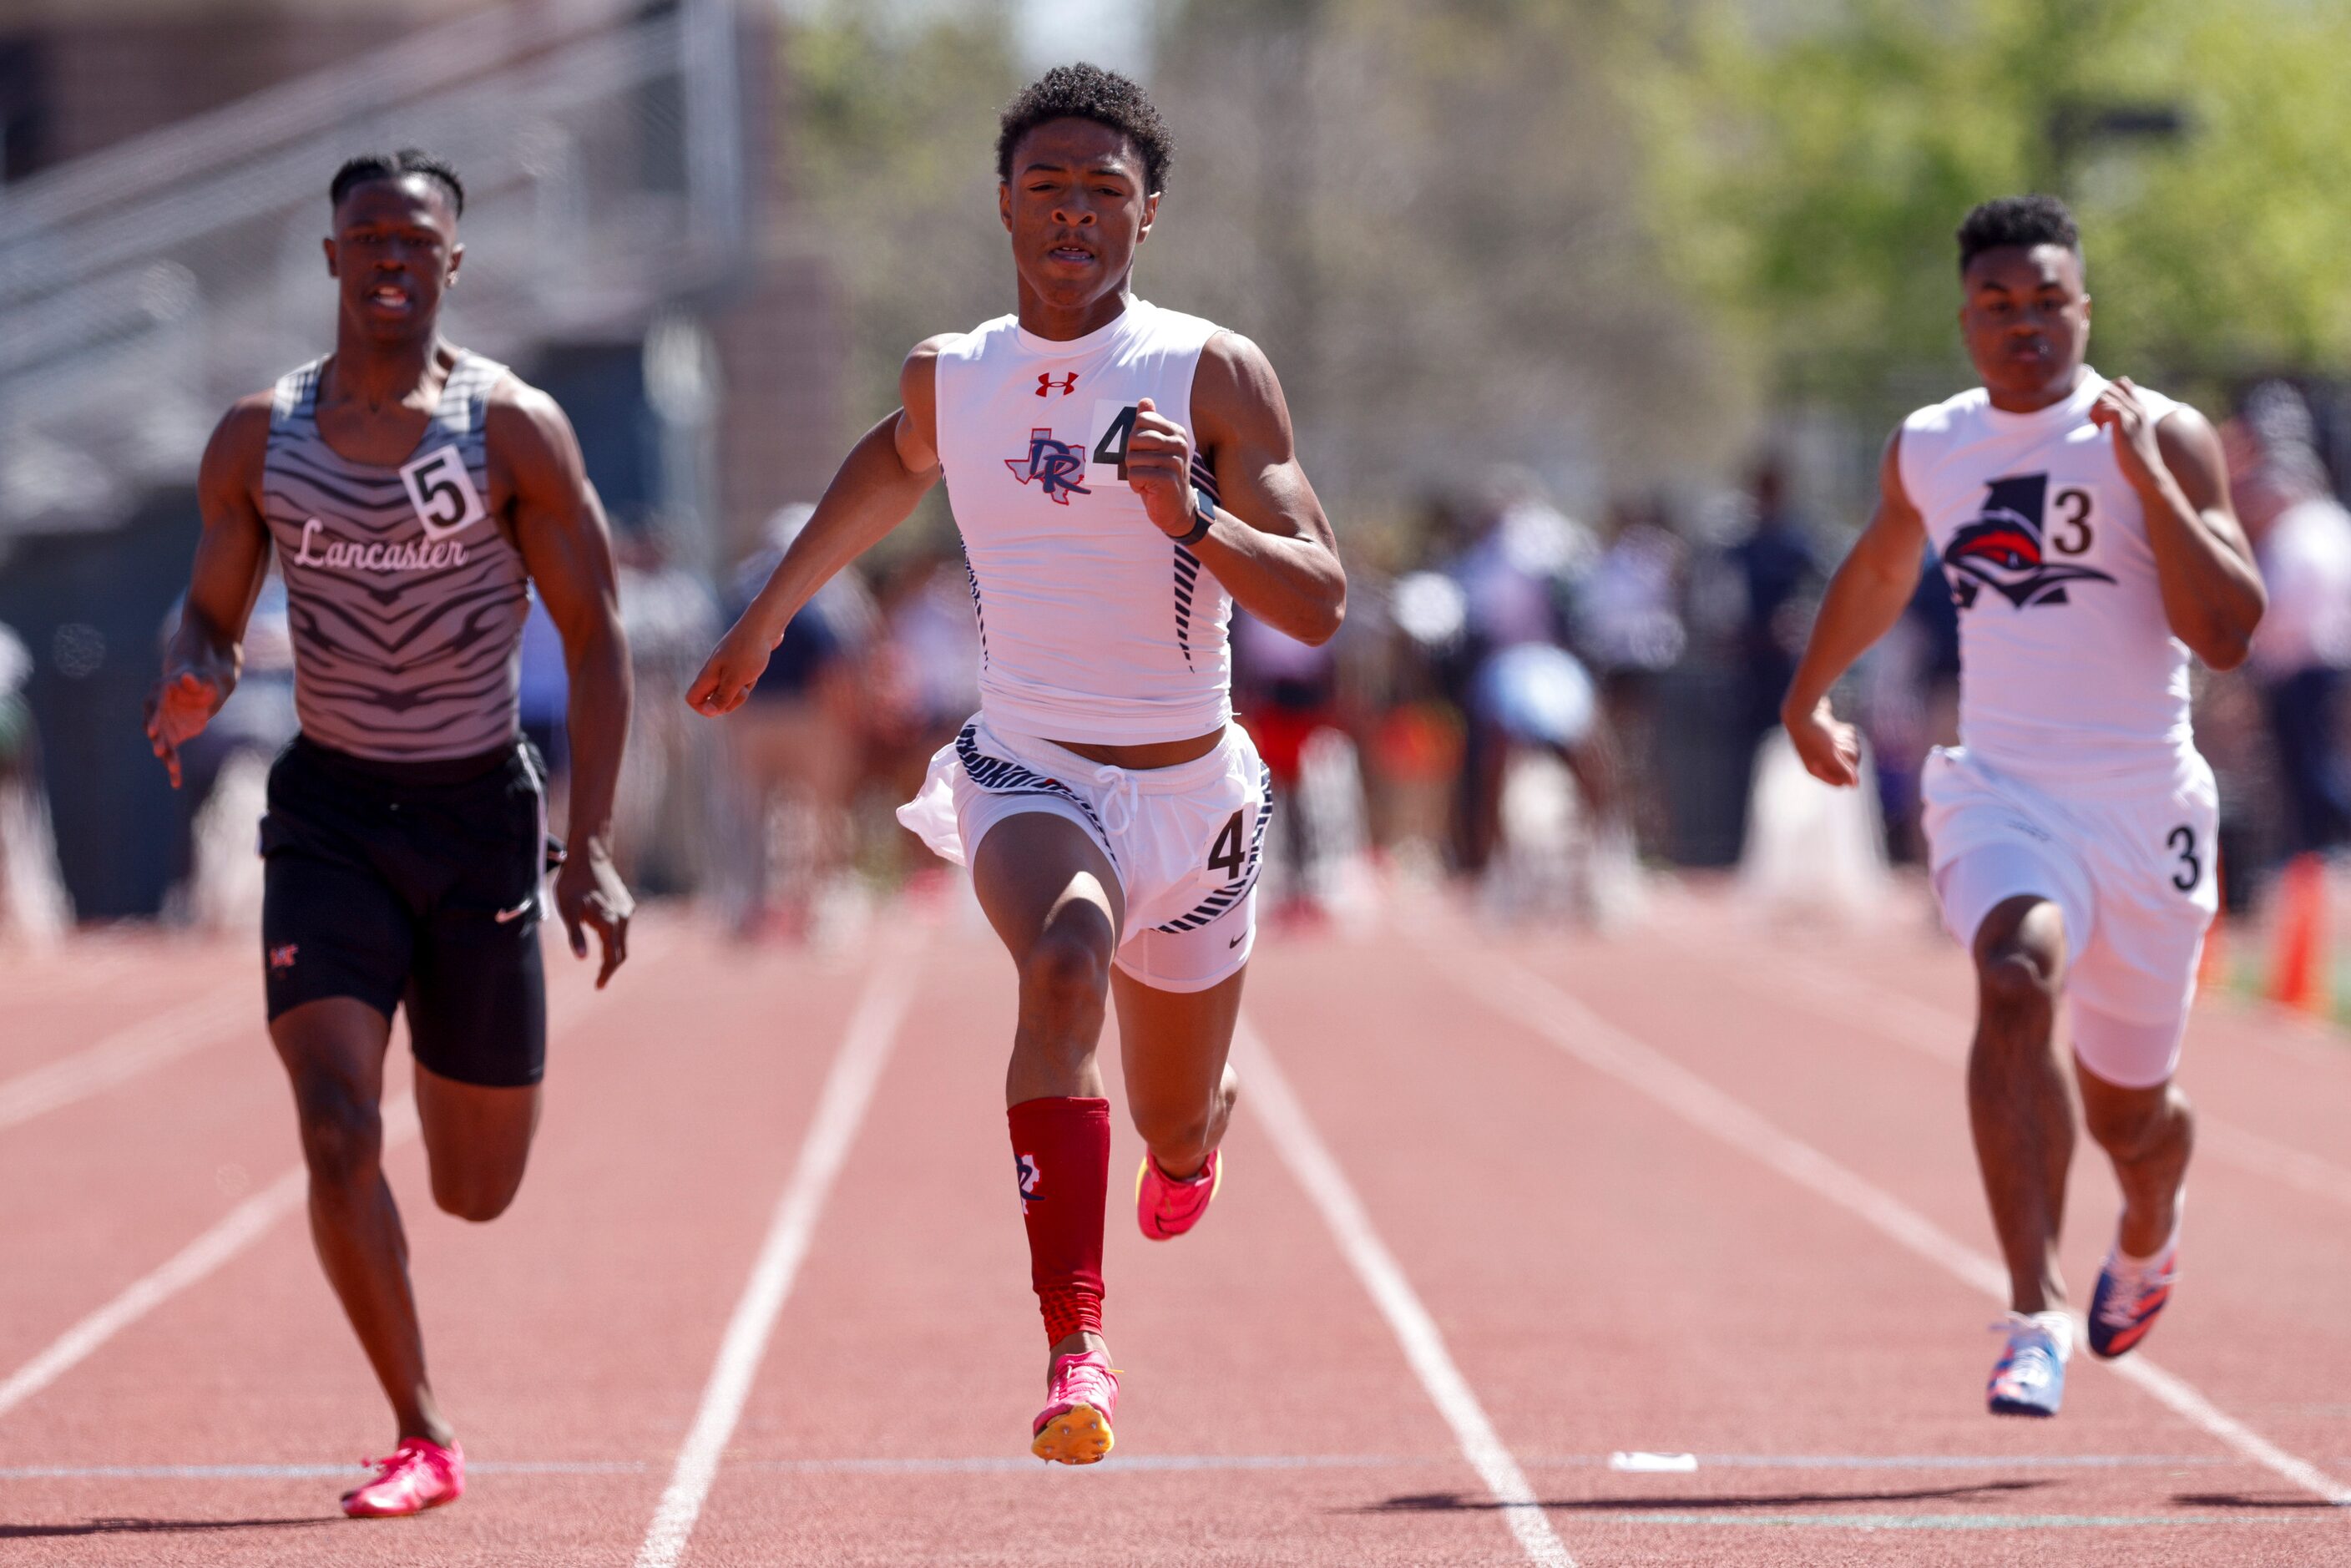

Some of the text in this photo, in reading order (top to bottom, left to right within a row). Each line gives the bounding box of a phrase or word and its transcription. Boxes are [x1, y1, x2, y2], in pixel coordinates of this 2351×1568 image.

[1029, 439, 1092, 495] DR
[1093, 406, 1137, 481] 4
[413, 458, 467, 529] 5
[2052, 488, 2094, 555] 3
[293, 516, 469, 570] Lancaster
[1207, 808, 1246, 881] 4
[2166, 825, 2200, 893] 3
